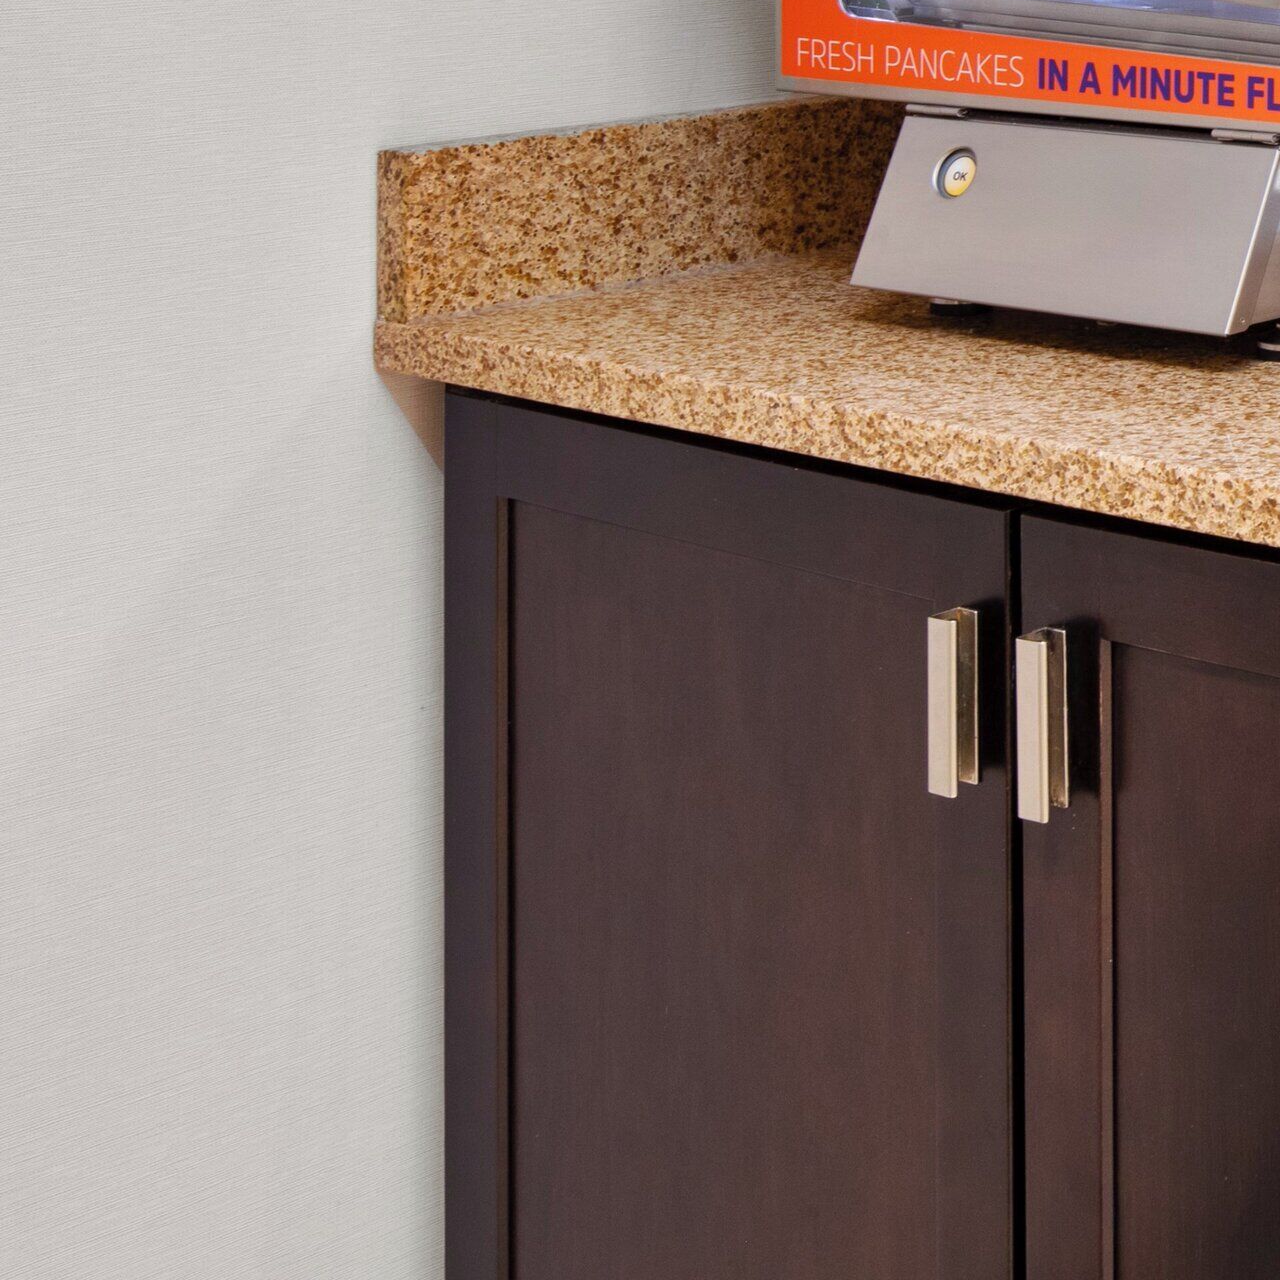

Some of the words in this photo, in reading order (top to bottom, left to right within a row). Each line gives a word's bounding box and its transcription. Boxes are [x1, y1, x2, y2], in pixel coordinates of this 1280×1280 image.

[796, 37, 875, 74] FRESH
[885, 45, 1025, 88] PANCAKES
[1038, 57, 1069, 92] IN
[1079, 62, 1101, 95] A
[1112, 64, 1236, 108] MINUTE
[952, 171, 968, 182] OK
